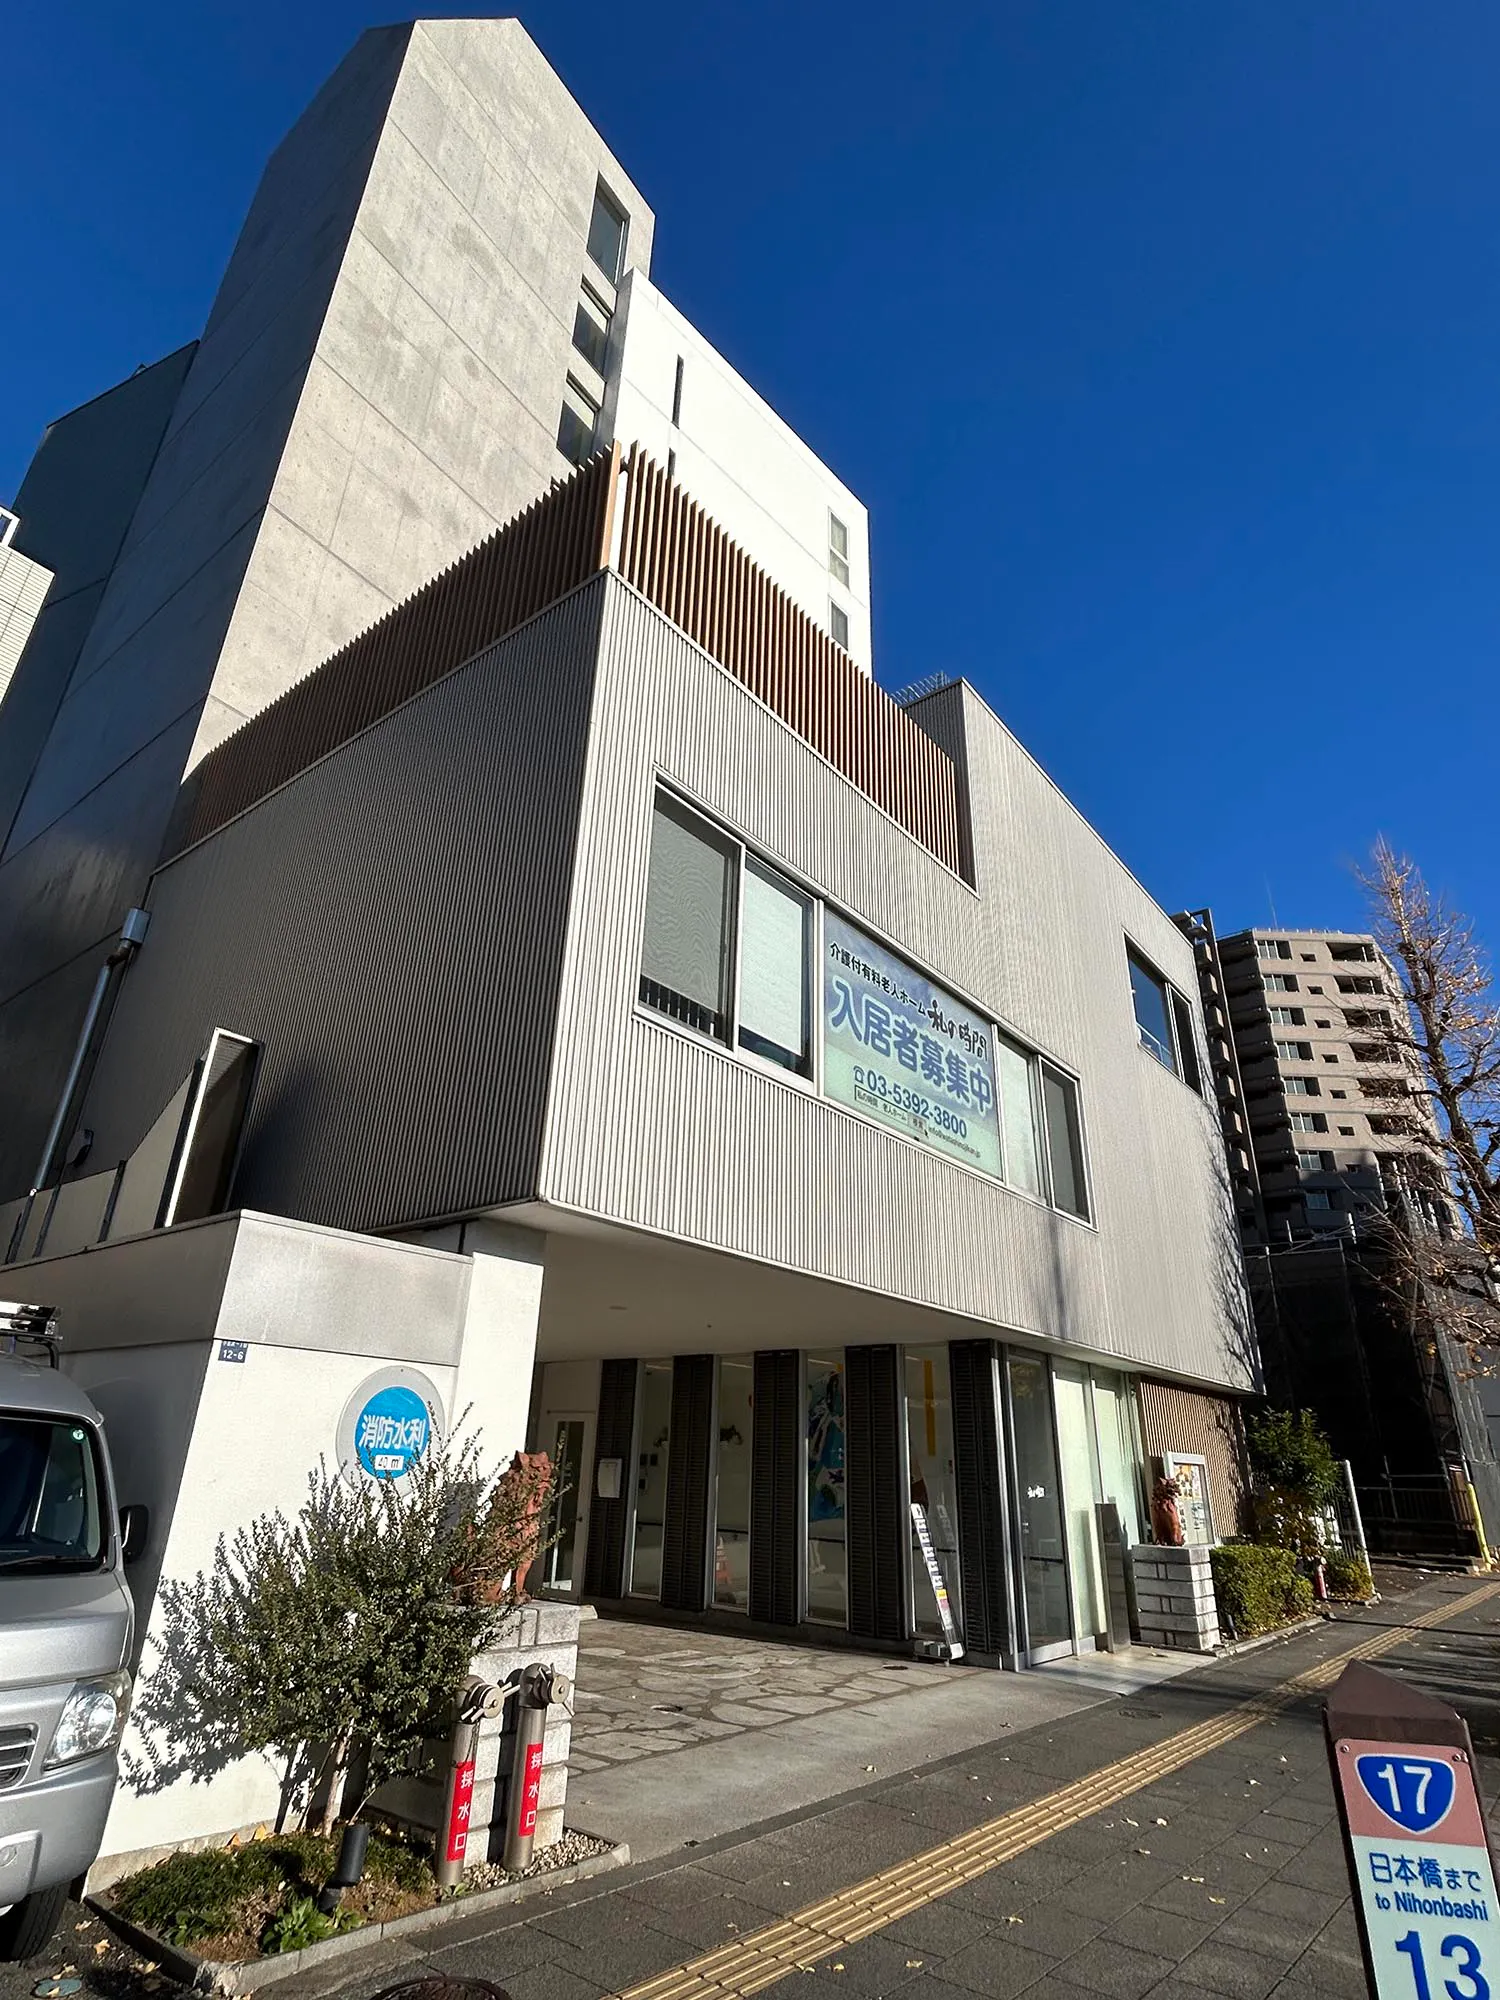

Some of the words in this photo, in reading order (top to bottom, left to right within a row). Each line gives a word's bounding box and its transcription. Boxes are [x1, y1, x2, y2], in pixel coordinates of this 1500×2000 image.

[829, 942, 926, 1016] 介護付有料老人ホーム
[830, 978, 992, 1114] 入居者募集中
[867, 1069, 967, 1139] 03-5392-3800
[223, 1349, 244, 1360] 12-6
[358, 1414, 427, 1451] 消防水利
[454, 1769, 474, 1851] 採水口
[525, 1751, 542, 1828] 採水口
[1376, 1763, 1433, 1815] 17
[1369, 1852, 1482, 1892] 日本橋まで
[1375, 1893, 1391, 1910] to
[1394, 1890, 1489, 1921] Nihonbashi
[1395, 1930, 1491, 2000] 13
